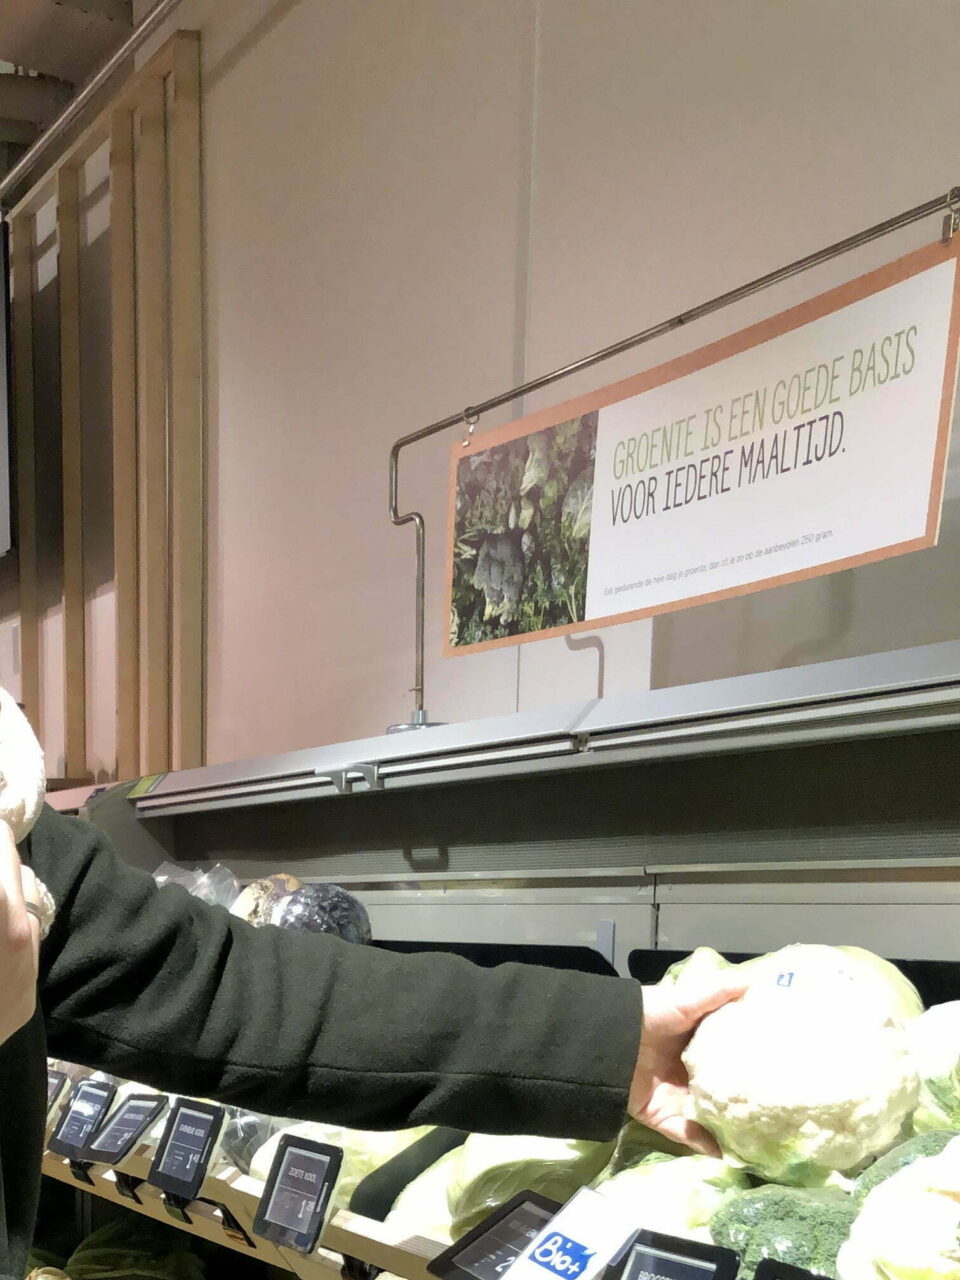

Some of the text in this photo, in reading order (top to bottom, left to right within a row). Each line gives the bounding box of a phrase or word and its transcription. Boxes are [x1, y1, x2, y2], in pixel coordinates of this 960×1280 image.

[614, 325, 917, 480] GROENTE IS EEN GOEDE BASIS
[611, 410, 846, 526] VOOR IEDERE MAALTIJD.
[800, 533, 813, 546] 250
